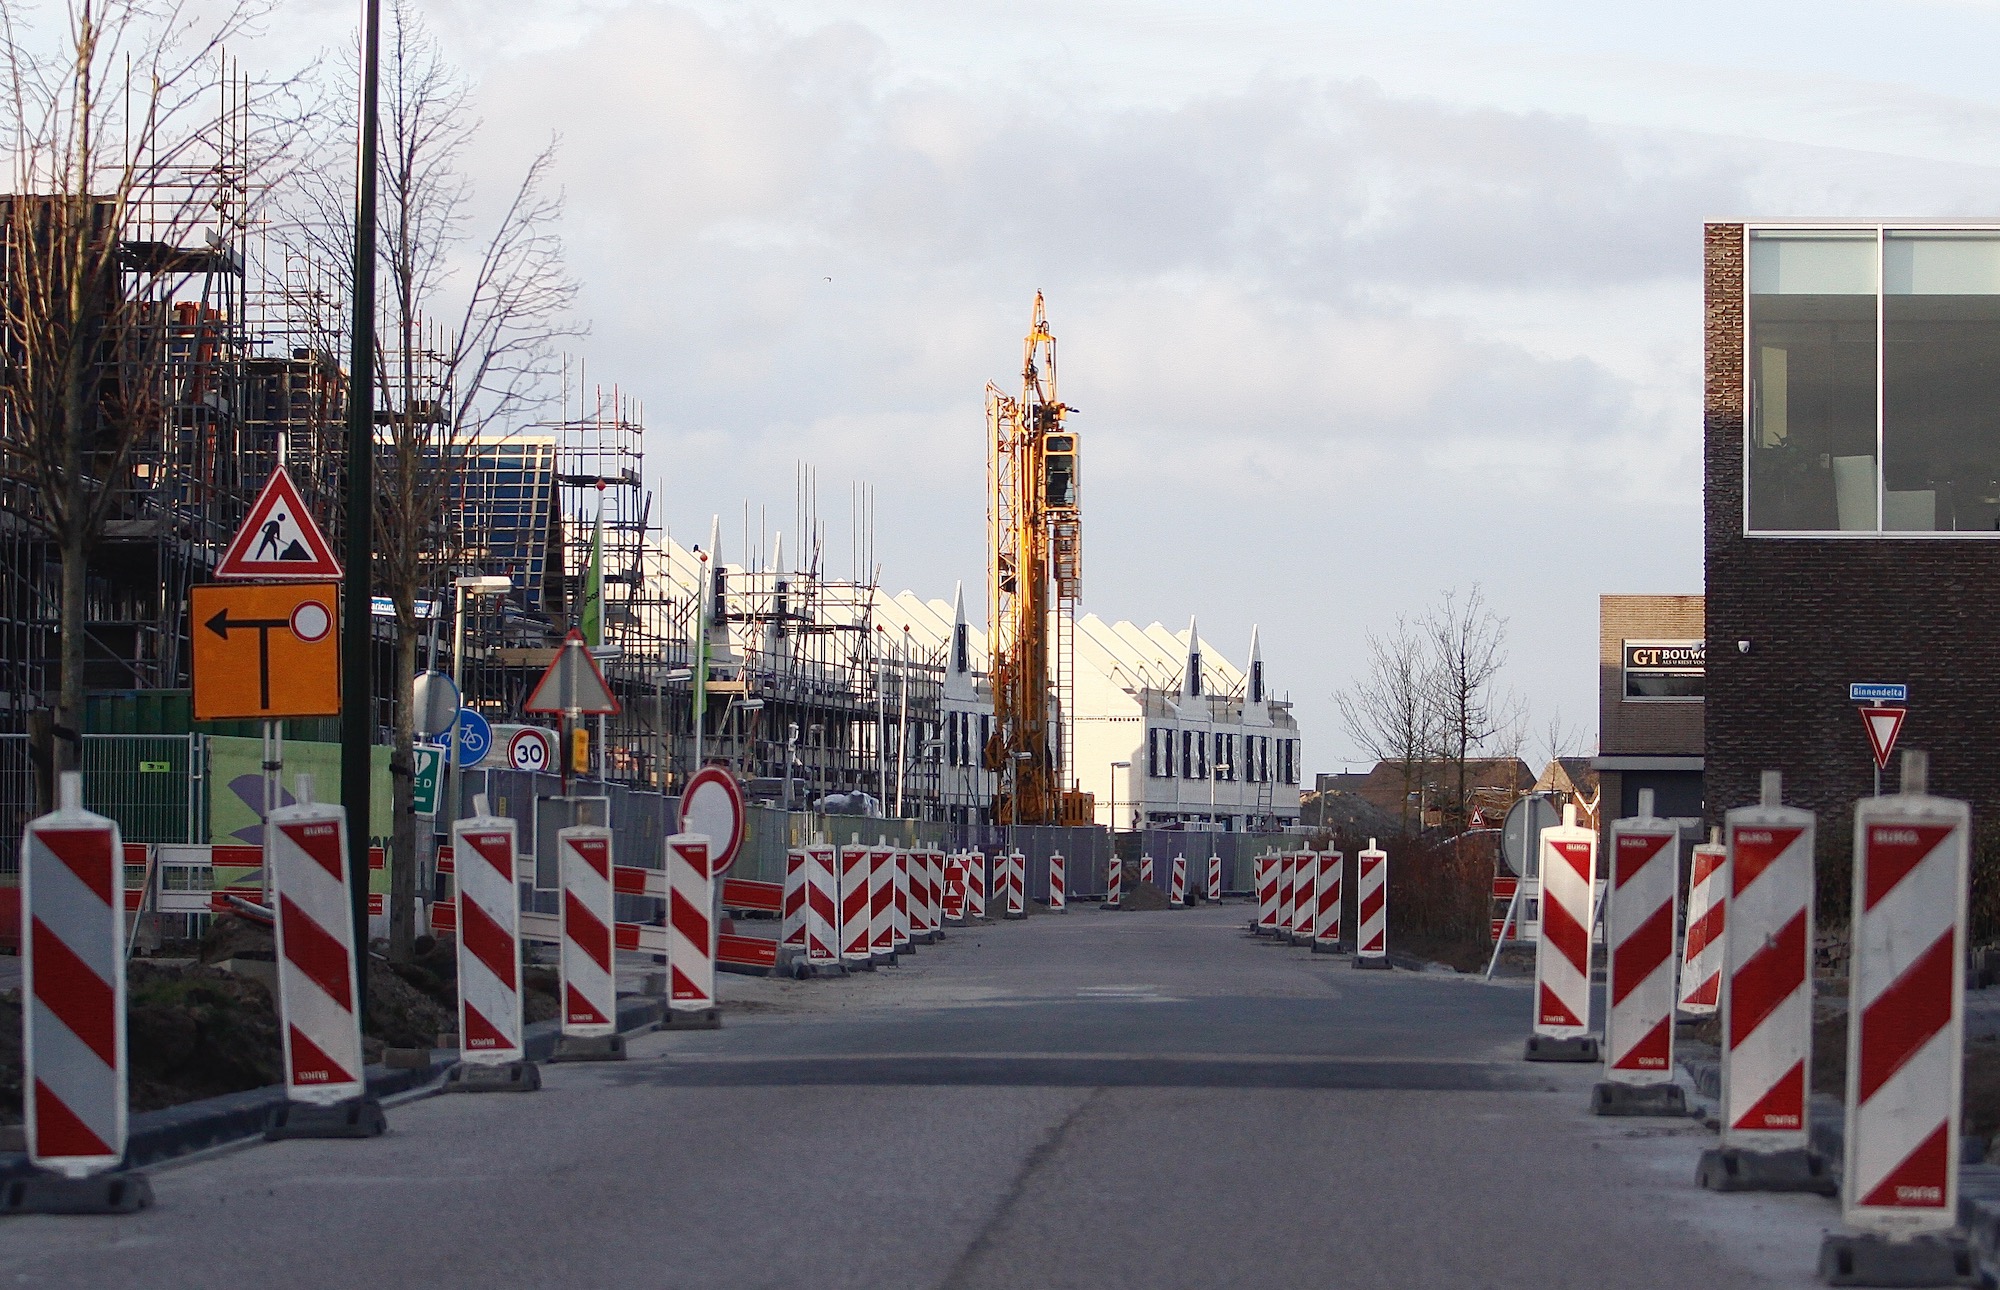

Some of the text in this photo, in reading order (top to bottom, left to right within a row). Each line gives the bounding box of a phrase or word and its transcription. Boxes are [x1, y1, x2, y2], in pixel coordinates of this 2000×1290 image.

[1633, 650, 1660, 664] GT
[1853, 687, 1902, 696] Binnendelta
[518, 744, 542, 763] 30
[414, 777, 432, 788] ED
